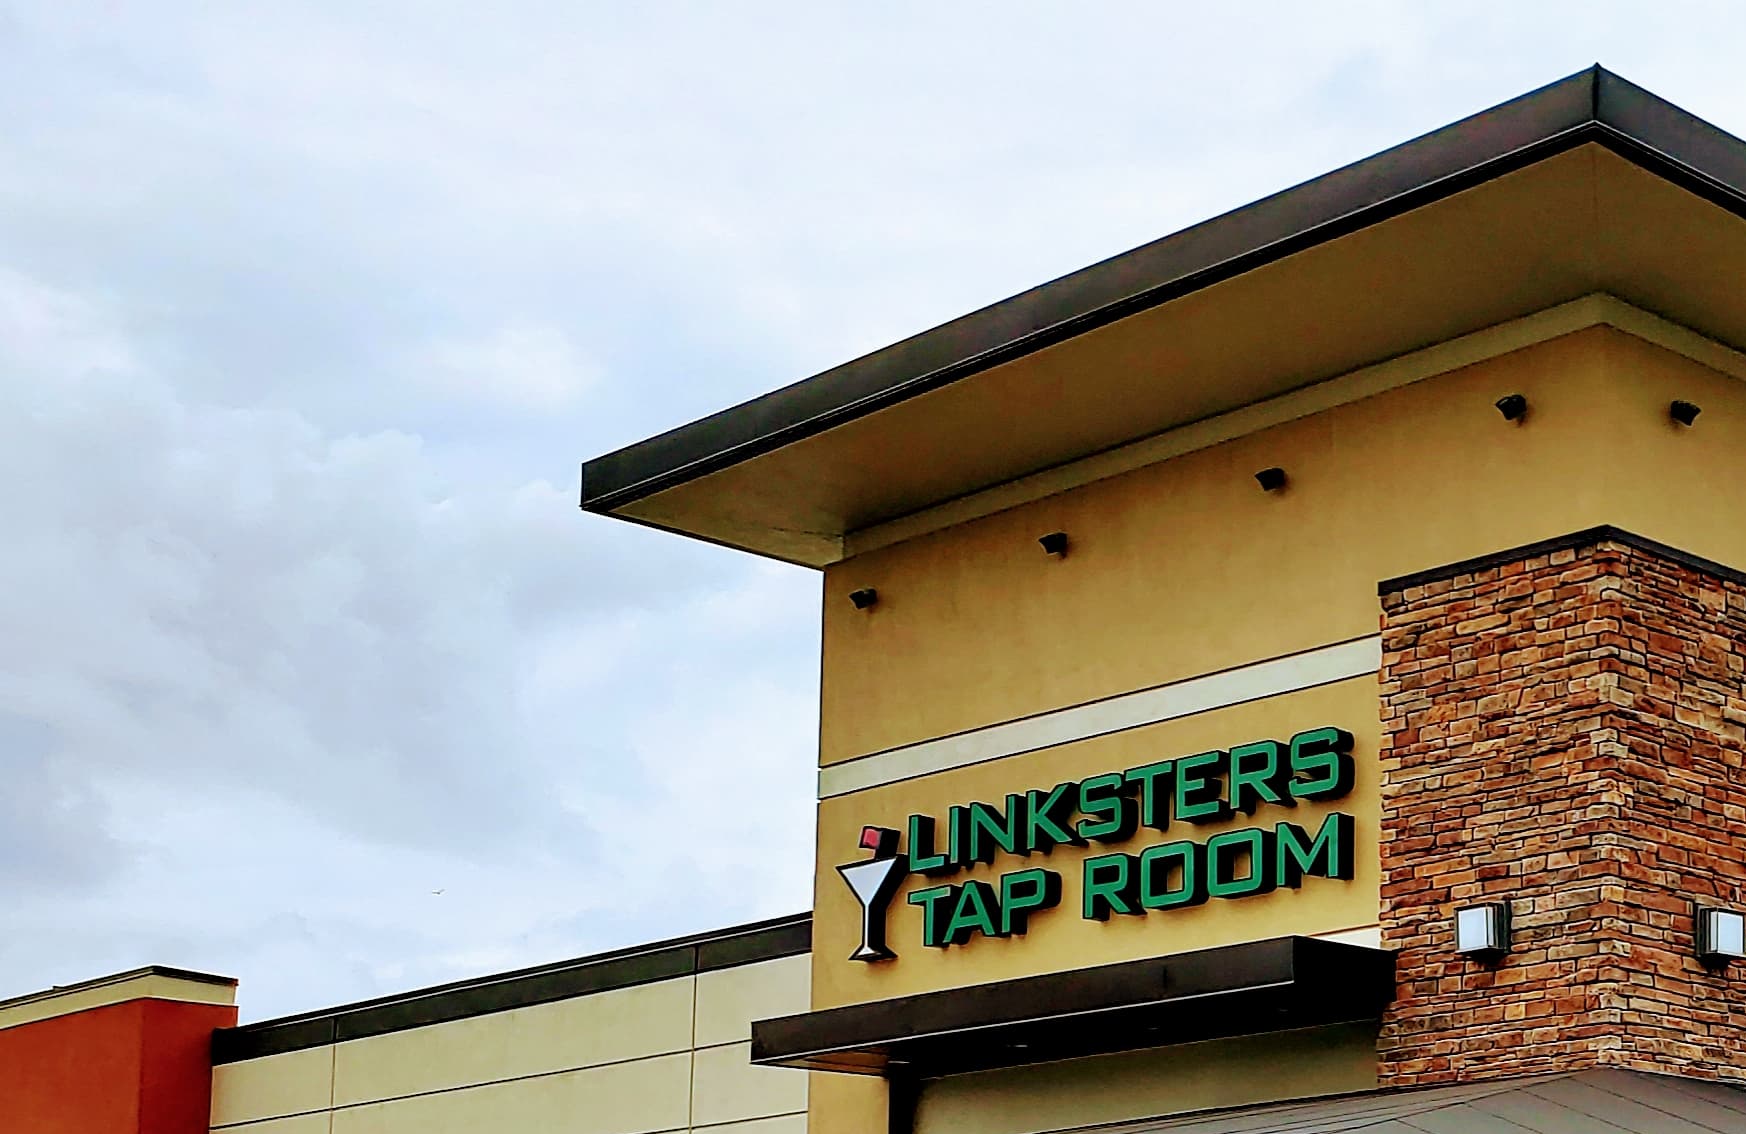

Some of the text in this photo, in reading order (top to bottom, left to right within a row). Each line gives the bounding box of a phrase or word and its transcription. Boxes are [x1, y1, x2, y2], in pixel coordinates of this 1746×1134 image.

[908, 727, 1352, 873] LINKSTERS
[908, 812, 1353, 947] TAP ROOM
